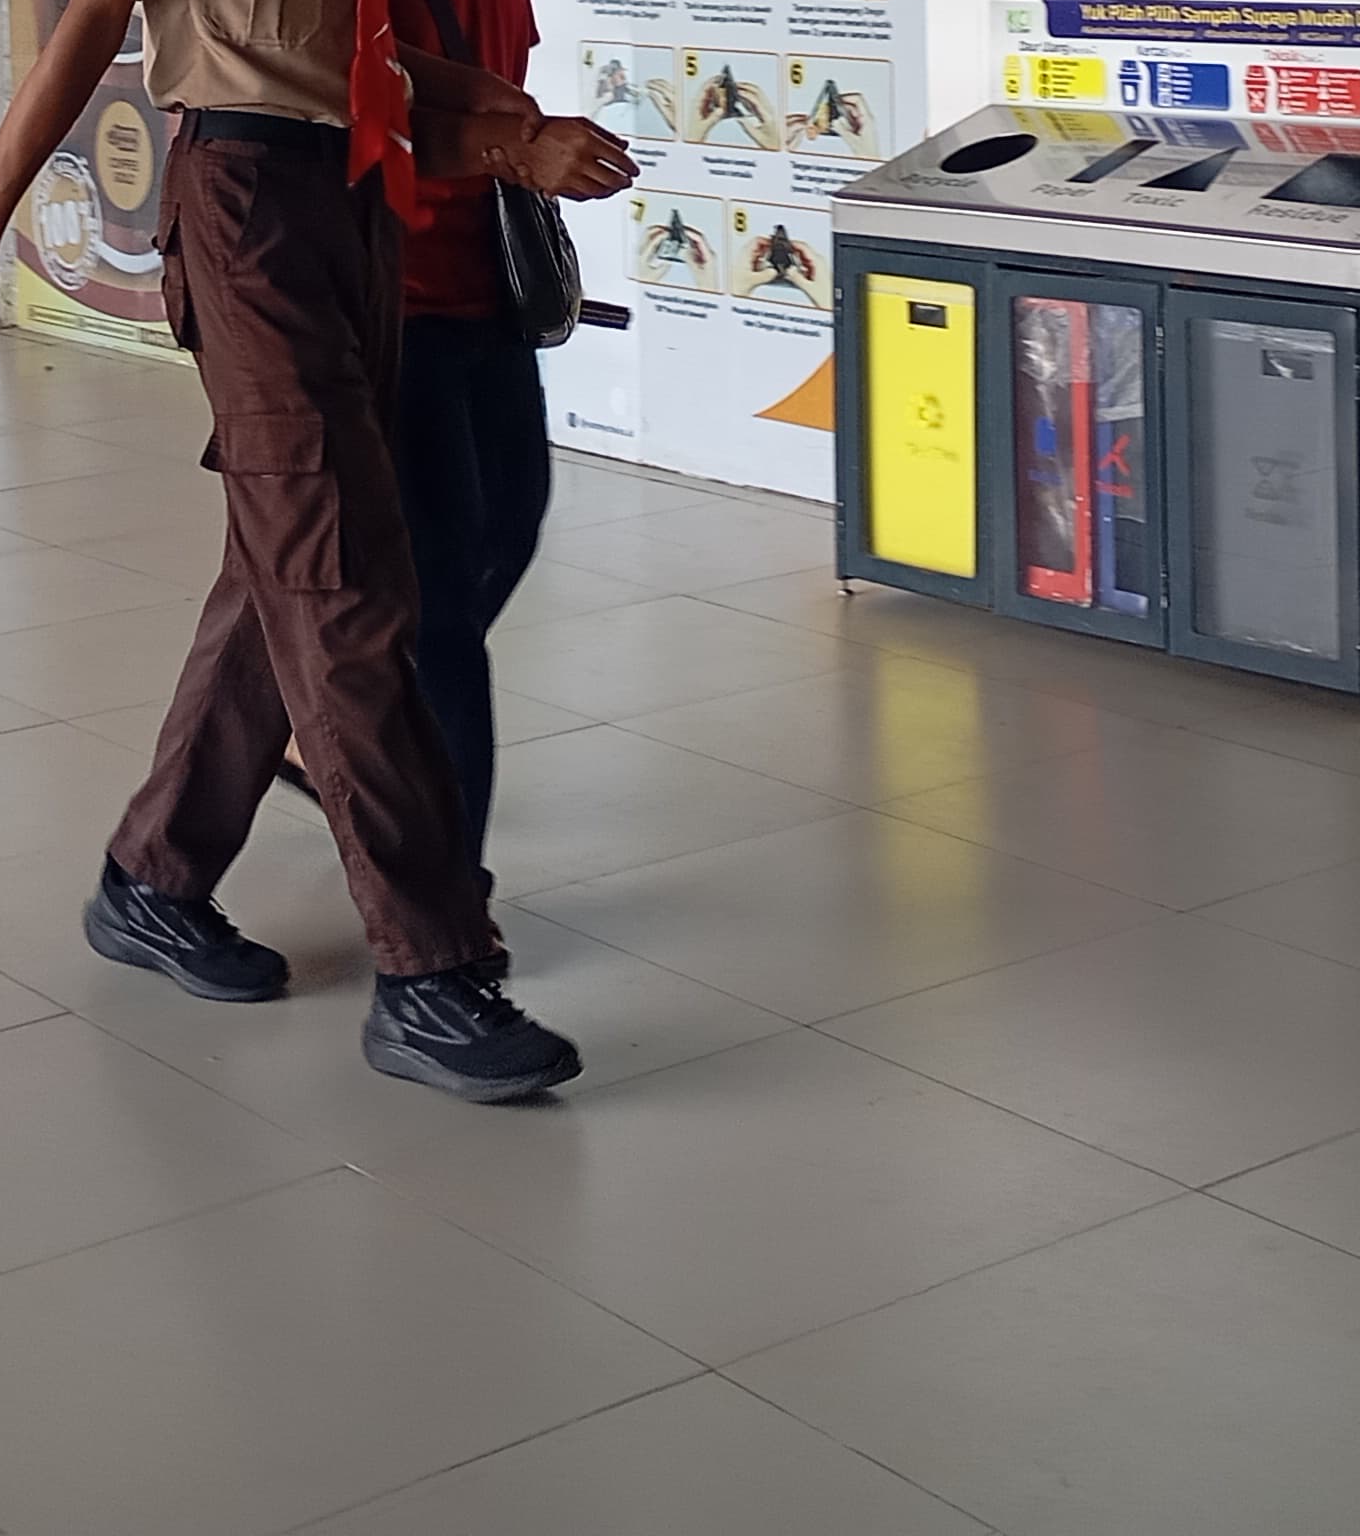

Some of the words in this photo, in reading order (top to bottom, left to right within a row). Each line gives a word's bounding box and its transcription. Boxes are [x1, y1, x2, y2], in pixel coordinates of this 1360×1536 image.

[685, 55, 699, 78] 5
[790, 63, 804, 85] 6
[1030, 182, 1096, 202] Paper
[1121, 191, 1185, 210] Toxic
[628, 199, 646, 222] 7
[732, 210, 748, 233] 8
[1246, 203, 1351, 227] Residue
